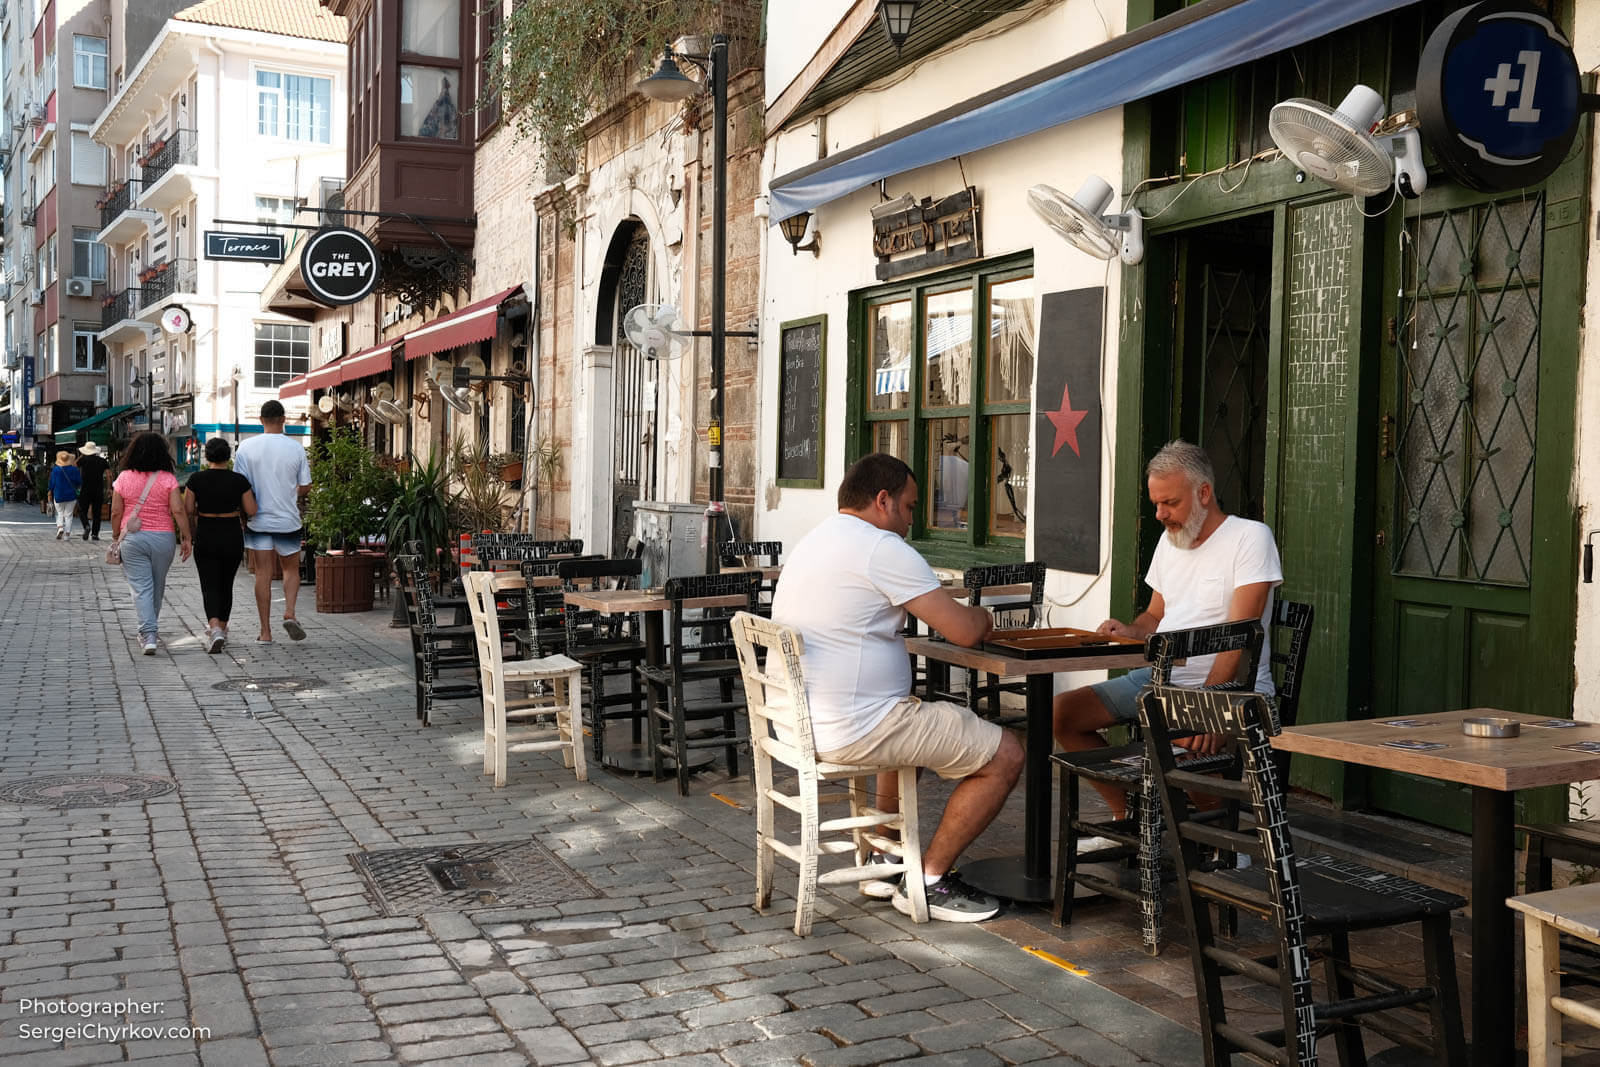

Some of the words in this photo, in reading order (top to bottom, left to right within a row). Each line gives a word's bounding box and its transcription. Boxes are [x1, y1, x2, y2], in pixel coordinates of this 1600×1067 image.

[1484, 50, 1541, 122] +1
[218, 237, 271, 254] Terrace
[312, 262, 371, 277] GREY
